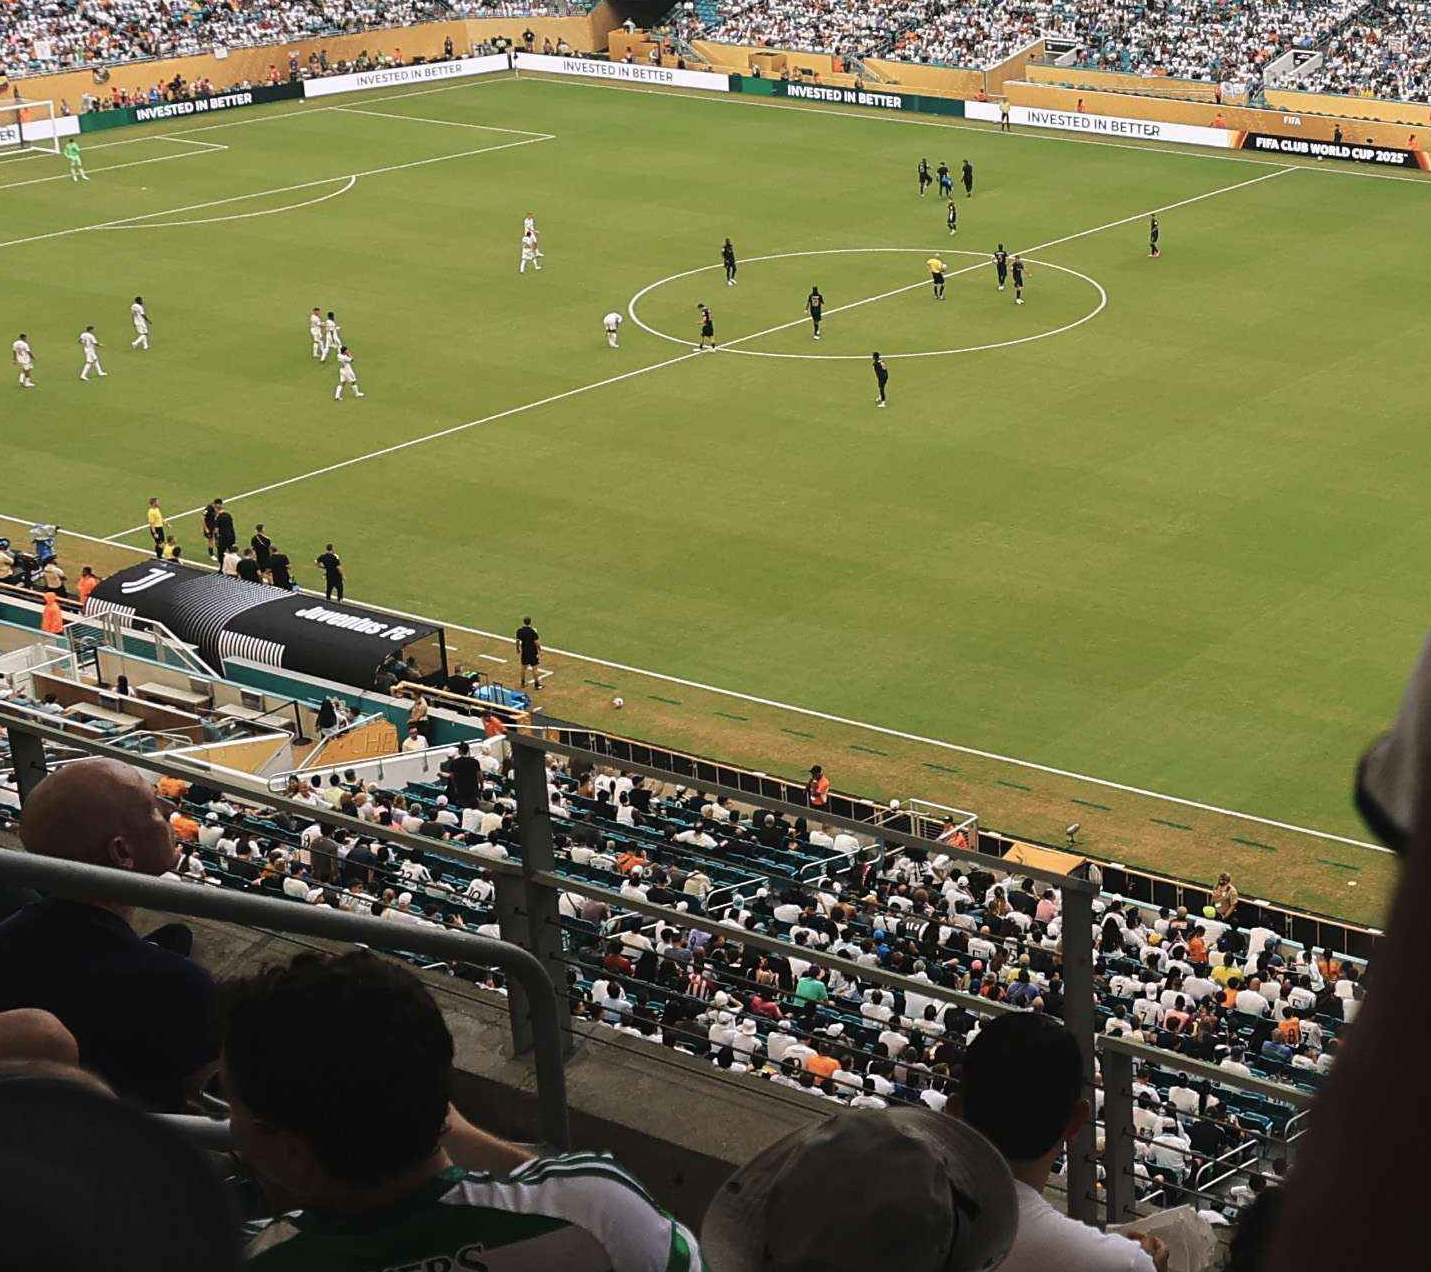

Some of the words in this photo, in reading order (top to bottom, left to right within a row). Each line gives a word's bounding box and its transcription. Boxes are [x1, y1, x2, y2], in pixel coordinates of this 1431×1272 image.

[357, 69, 408, 86] INVESTED
[410, 67, 422, 80] IN
[425, 64, 462, 78] BETTER
[563, 61, 616, 75] INVESTED
[618, 66, 629, 76] IN
[633, 67, 673, 82] BETTER
[136, 100, 192, 121] INVESTED
[195, 97, 208, 111] IN
[210, 92, 252, 109] BETTER
[787, 84, 841, 101] INVESTED
[844, 90, 856, 102] IN
[858, 91, 901, 108] BETTER
[1028, 111, 1090, 129] INVESTED
[1094, 118, 1107, 131] IN
[1111, 120, 1160, 137] BETTER
[1284, 115, 1301, 126] FIFA
[1256, 136, 1279, 150] FIFA
[1281, 139, 1308, 154] CLUB
[1310, 142, 1350, 158] WORLD
[1352, 147, 1374, 159] CUP
[295, 606, 389, 634] Juventus
